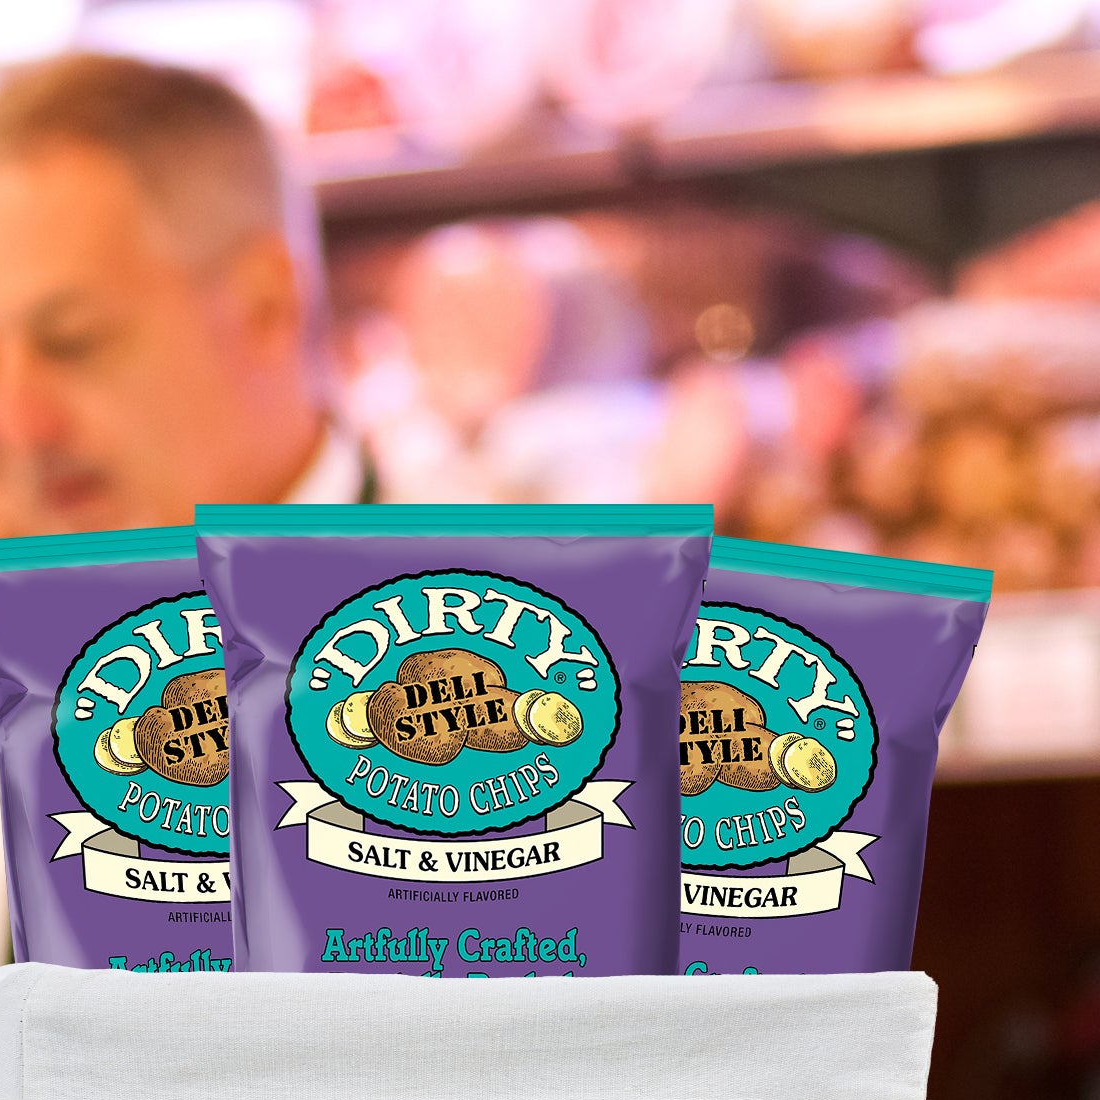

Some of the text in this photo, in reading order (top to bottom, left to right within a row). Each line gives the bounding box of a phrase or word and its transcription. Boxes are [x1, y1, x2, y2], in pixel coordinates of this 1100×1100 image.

[402, 671, 488, 710] DELI
[682, 618, 860, 742] RTY"
[395, 698, 508, 743] STYLE
[346, 752, 560, 817] POTATO CHIPS
[117, 780, 230, 838] POTATO
[714, 796, 806, 851] CHIPS
[347, 841, 561, 873] SALT & VINEGAR
[125, 868, 189, 893] SALT
[196, 872, 217, 893] &
[387, 888, 520, 902] ARTIFICIALLY FLAVORED
[683, 883, 798, 908] VINEGAR
[321, 927, 587, 971] Artfully Crafted,
[695, 924, 752, 938] FLAVORED
